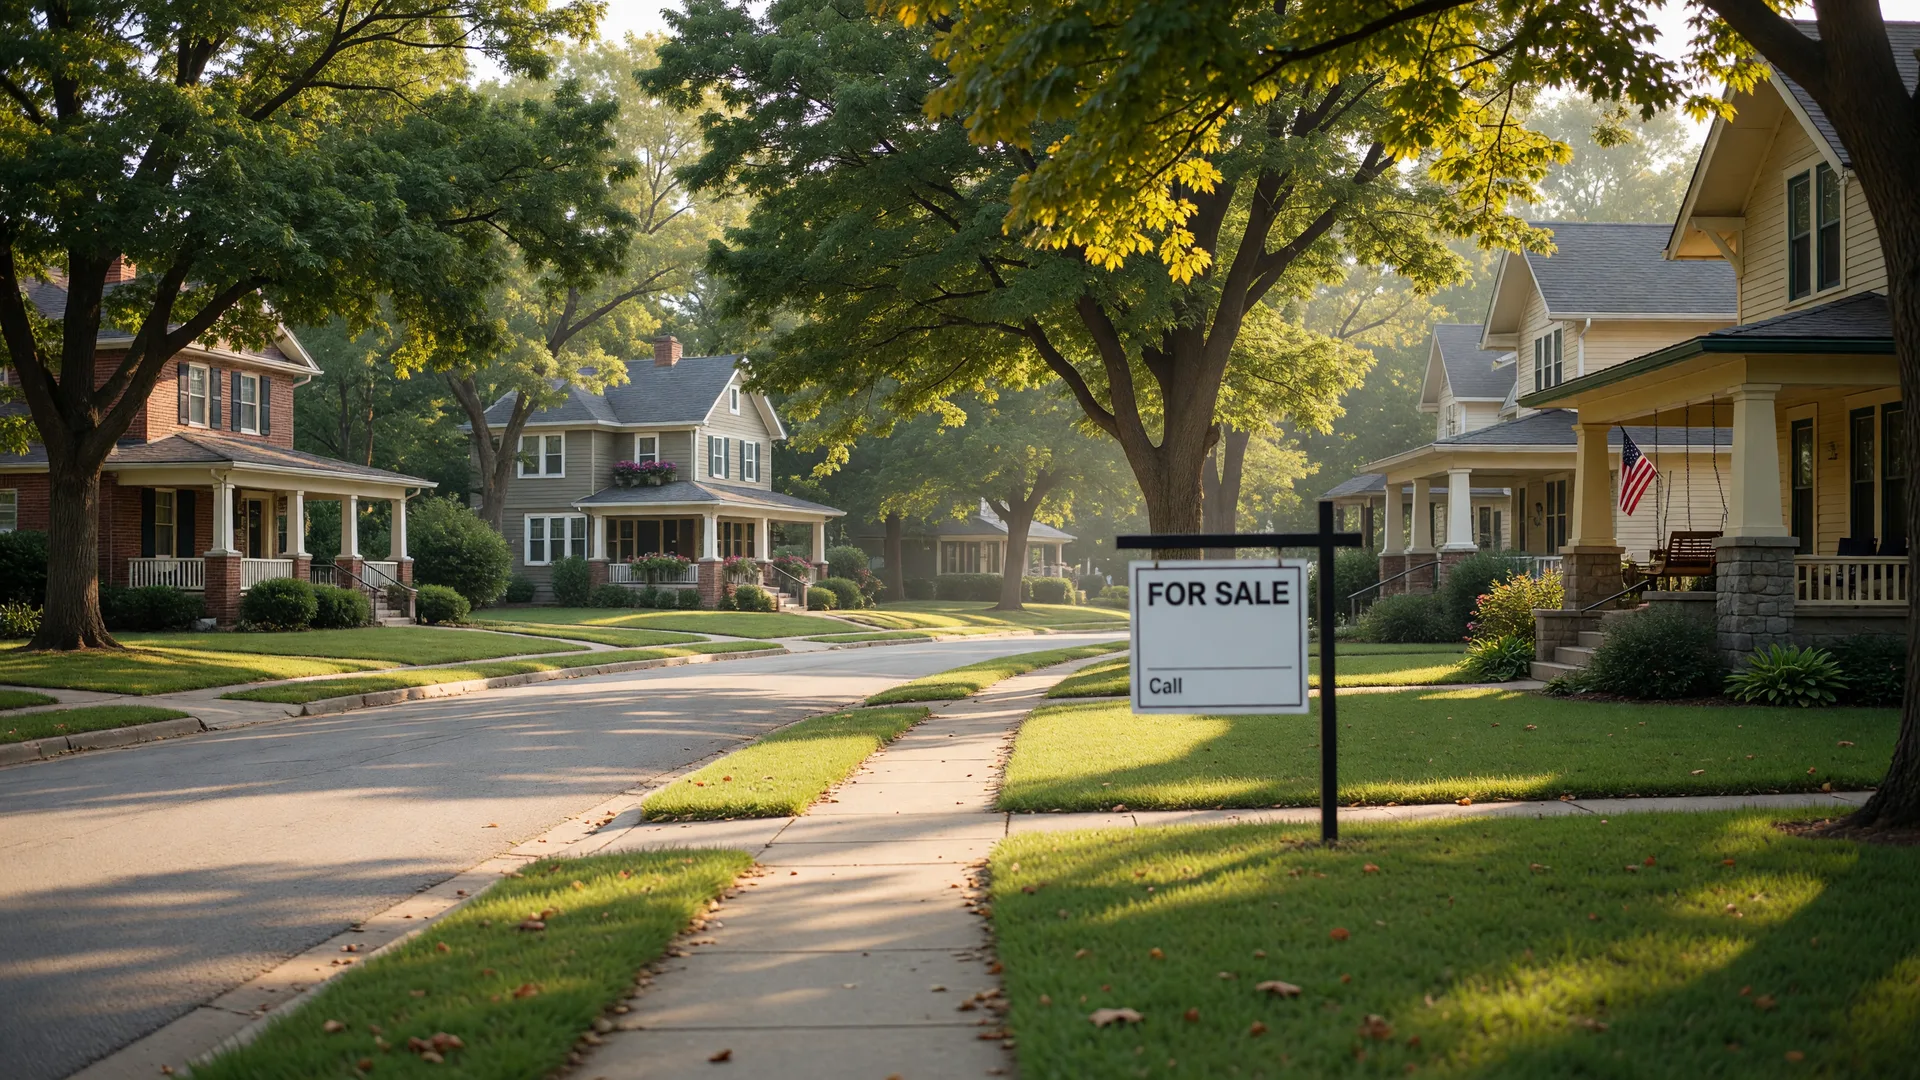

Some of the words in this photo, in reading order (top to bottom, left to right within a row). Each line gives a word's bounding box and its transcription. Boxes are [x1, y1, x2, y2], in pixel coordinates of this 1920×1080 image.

[1148, 581, 1207, 606] FOR
[1215, 580, 1290, 606] SALE
[1149, 677, 1183, 695] Call
